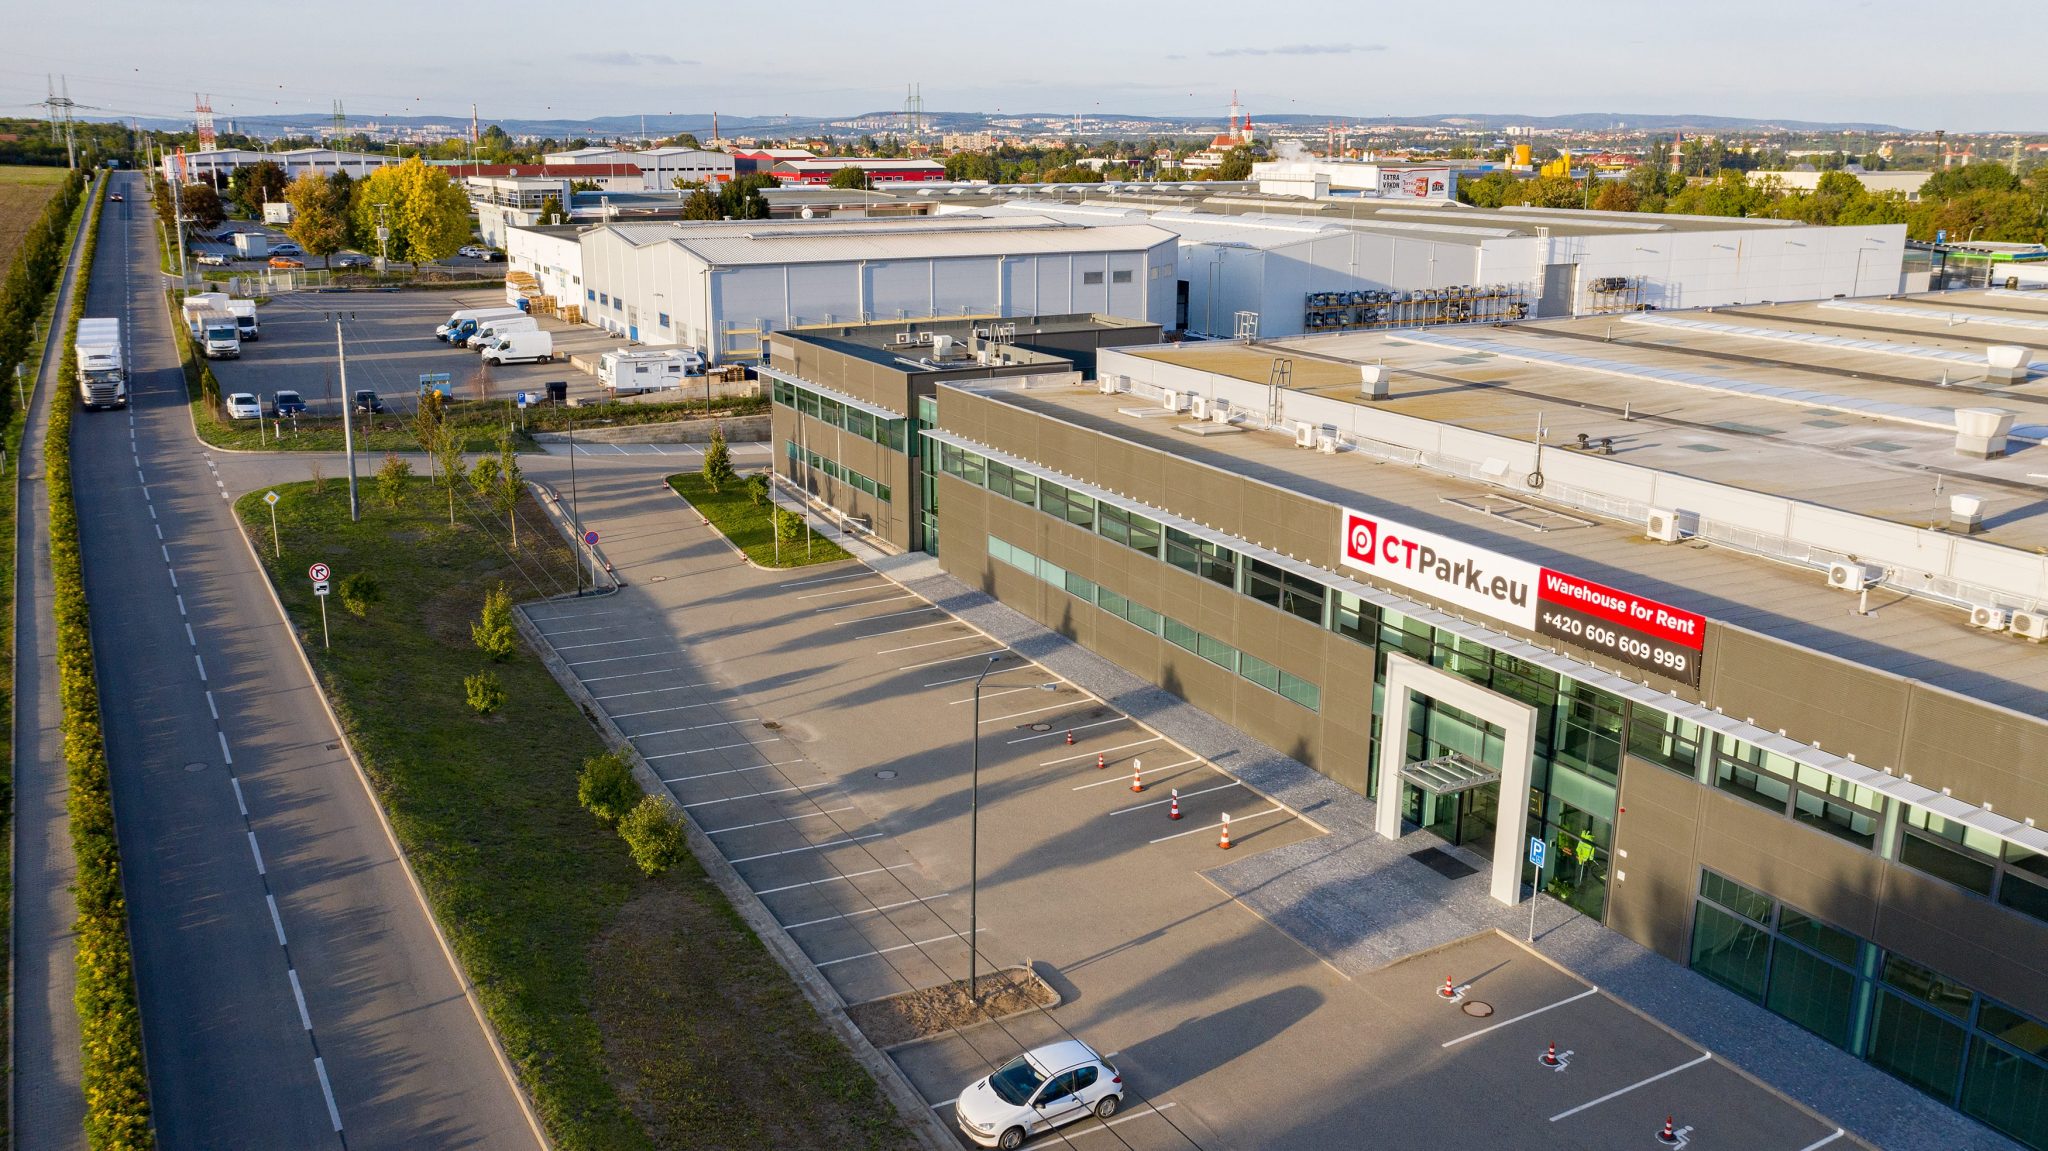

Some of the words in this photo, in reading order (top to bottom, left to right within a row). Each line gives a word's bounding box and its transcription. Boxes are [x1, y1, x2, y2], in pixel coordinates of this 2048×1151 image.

[1382, 535, 1528, 608] CTPark.eu
[1547, 575, 1627, 612] Warehouse
[1630, 600, 1653, 620] for
[1656, 611, 1695, 635] Rent
[1543, 612, 1582, 636] +420
[1585, 625, 1615, 647] 606
[1619, 635, 1650, 658] 609
[1653, 647, 1686, 671] 999
[1533, 841, 1542, 856] P
